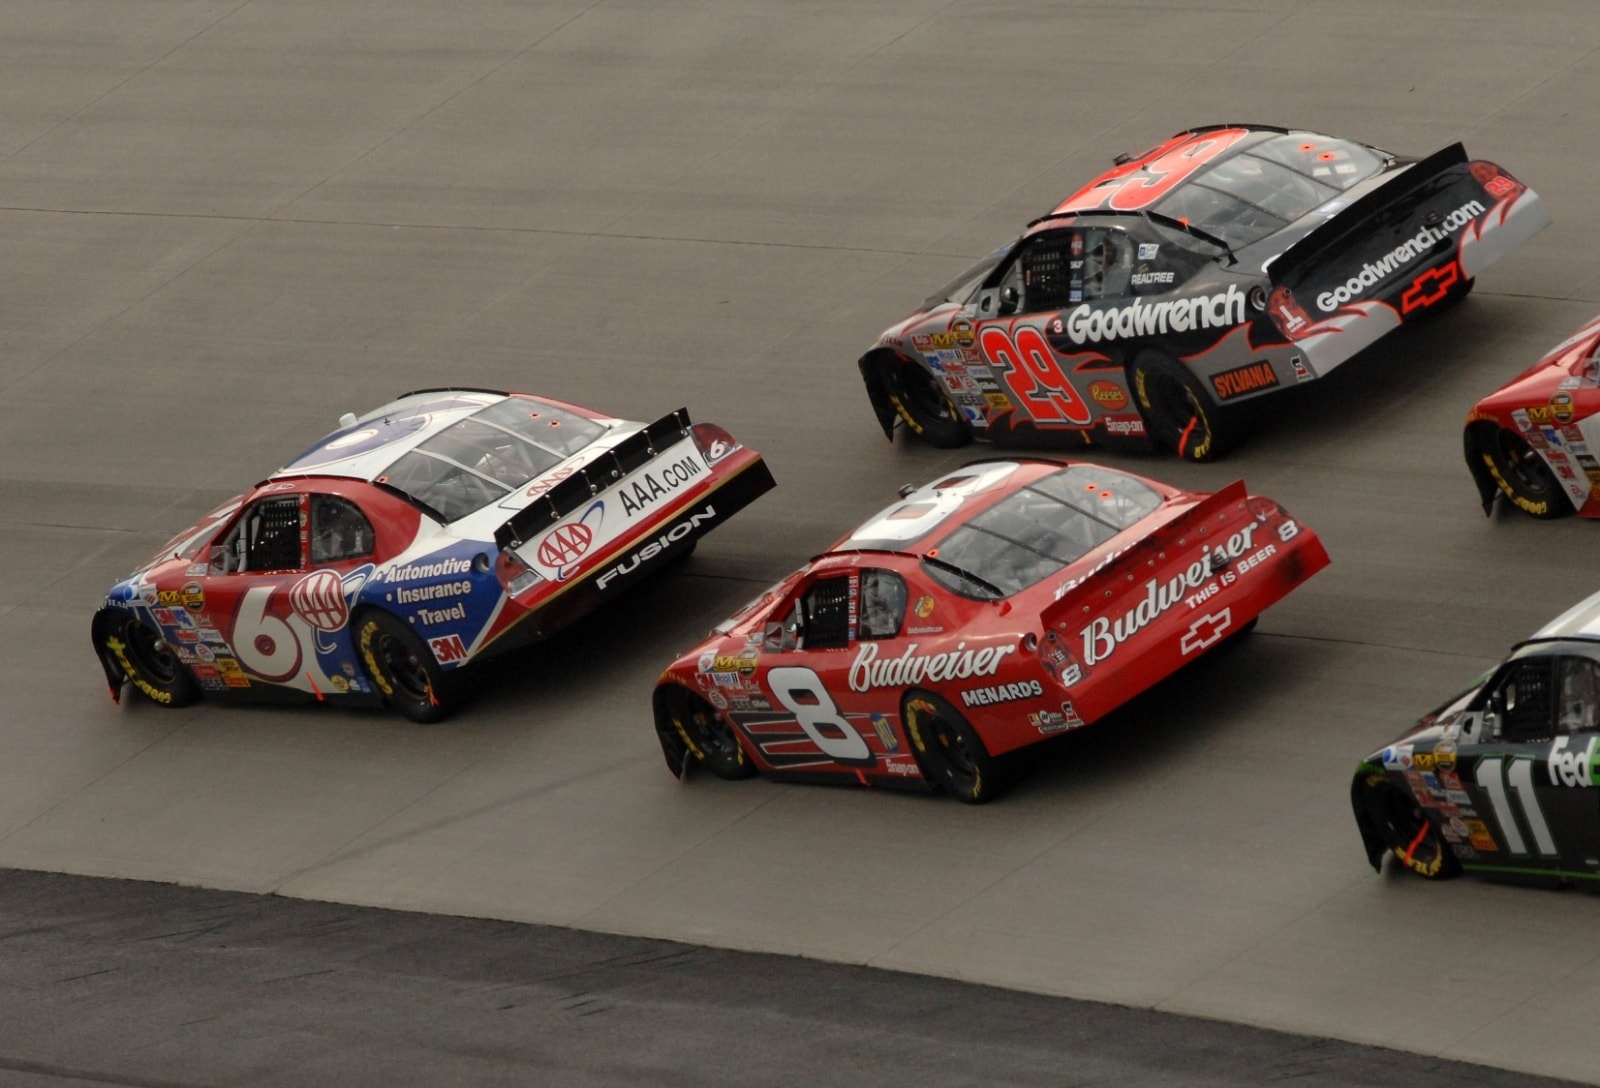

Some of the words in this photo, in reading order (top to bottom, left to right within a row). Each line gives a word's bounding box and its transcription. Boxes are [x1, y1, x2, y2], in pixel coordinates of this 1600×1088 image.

[1485, 176, 1514, 195] 29
[1316, 200, 1486, 312] Goodwrench.com
[1131, 272, 1174, 285] REALTREE
[1053, 320, 1063, 333] 3
[1067, 285, 1246, 345] Goodwrench
[980, 326, 1091, 426] 29
[1213, 364, 1276, 398] SYLVANIA
[1105, 417, 1143, 435] Snap-on
[710, 440, 725, 459] 6
[618, 456, 702, 517] AAA.COM
[540, 523, 591, 567] AAA
[595, 505, 717, 590] FUSION
[1278, 520, 1299, 542] 8
[385, 558, 472, 584] Automotive
[1185, 583, 1220, 609] THIS
[1221, 571, 1236, 586] IS
[1237, 544, 1277, 575] BEER
[397, 580, 472, 604] Insurance
[1080, 521, 1258, 666] Budweiser
[417, 603, 466, 626] Travel
[232, 586, 301, 680] 6
[431, 636, 469, 662] 3M
[848, 642, 1015, 692] Budweiser
[1062, 663, 1082, 687] 8
[961, 680, 1043, 706] MENARDS
[767, 667, 872, 760] 8
[1476, 758, 1557, 855] 11
